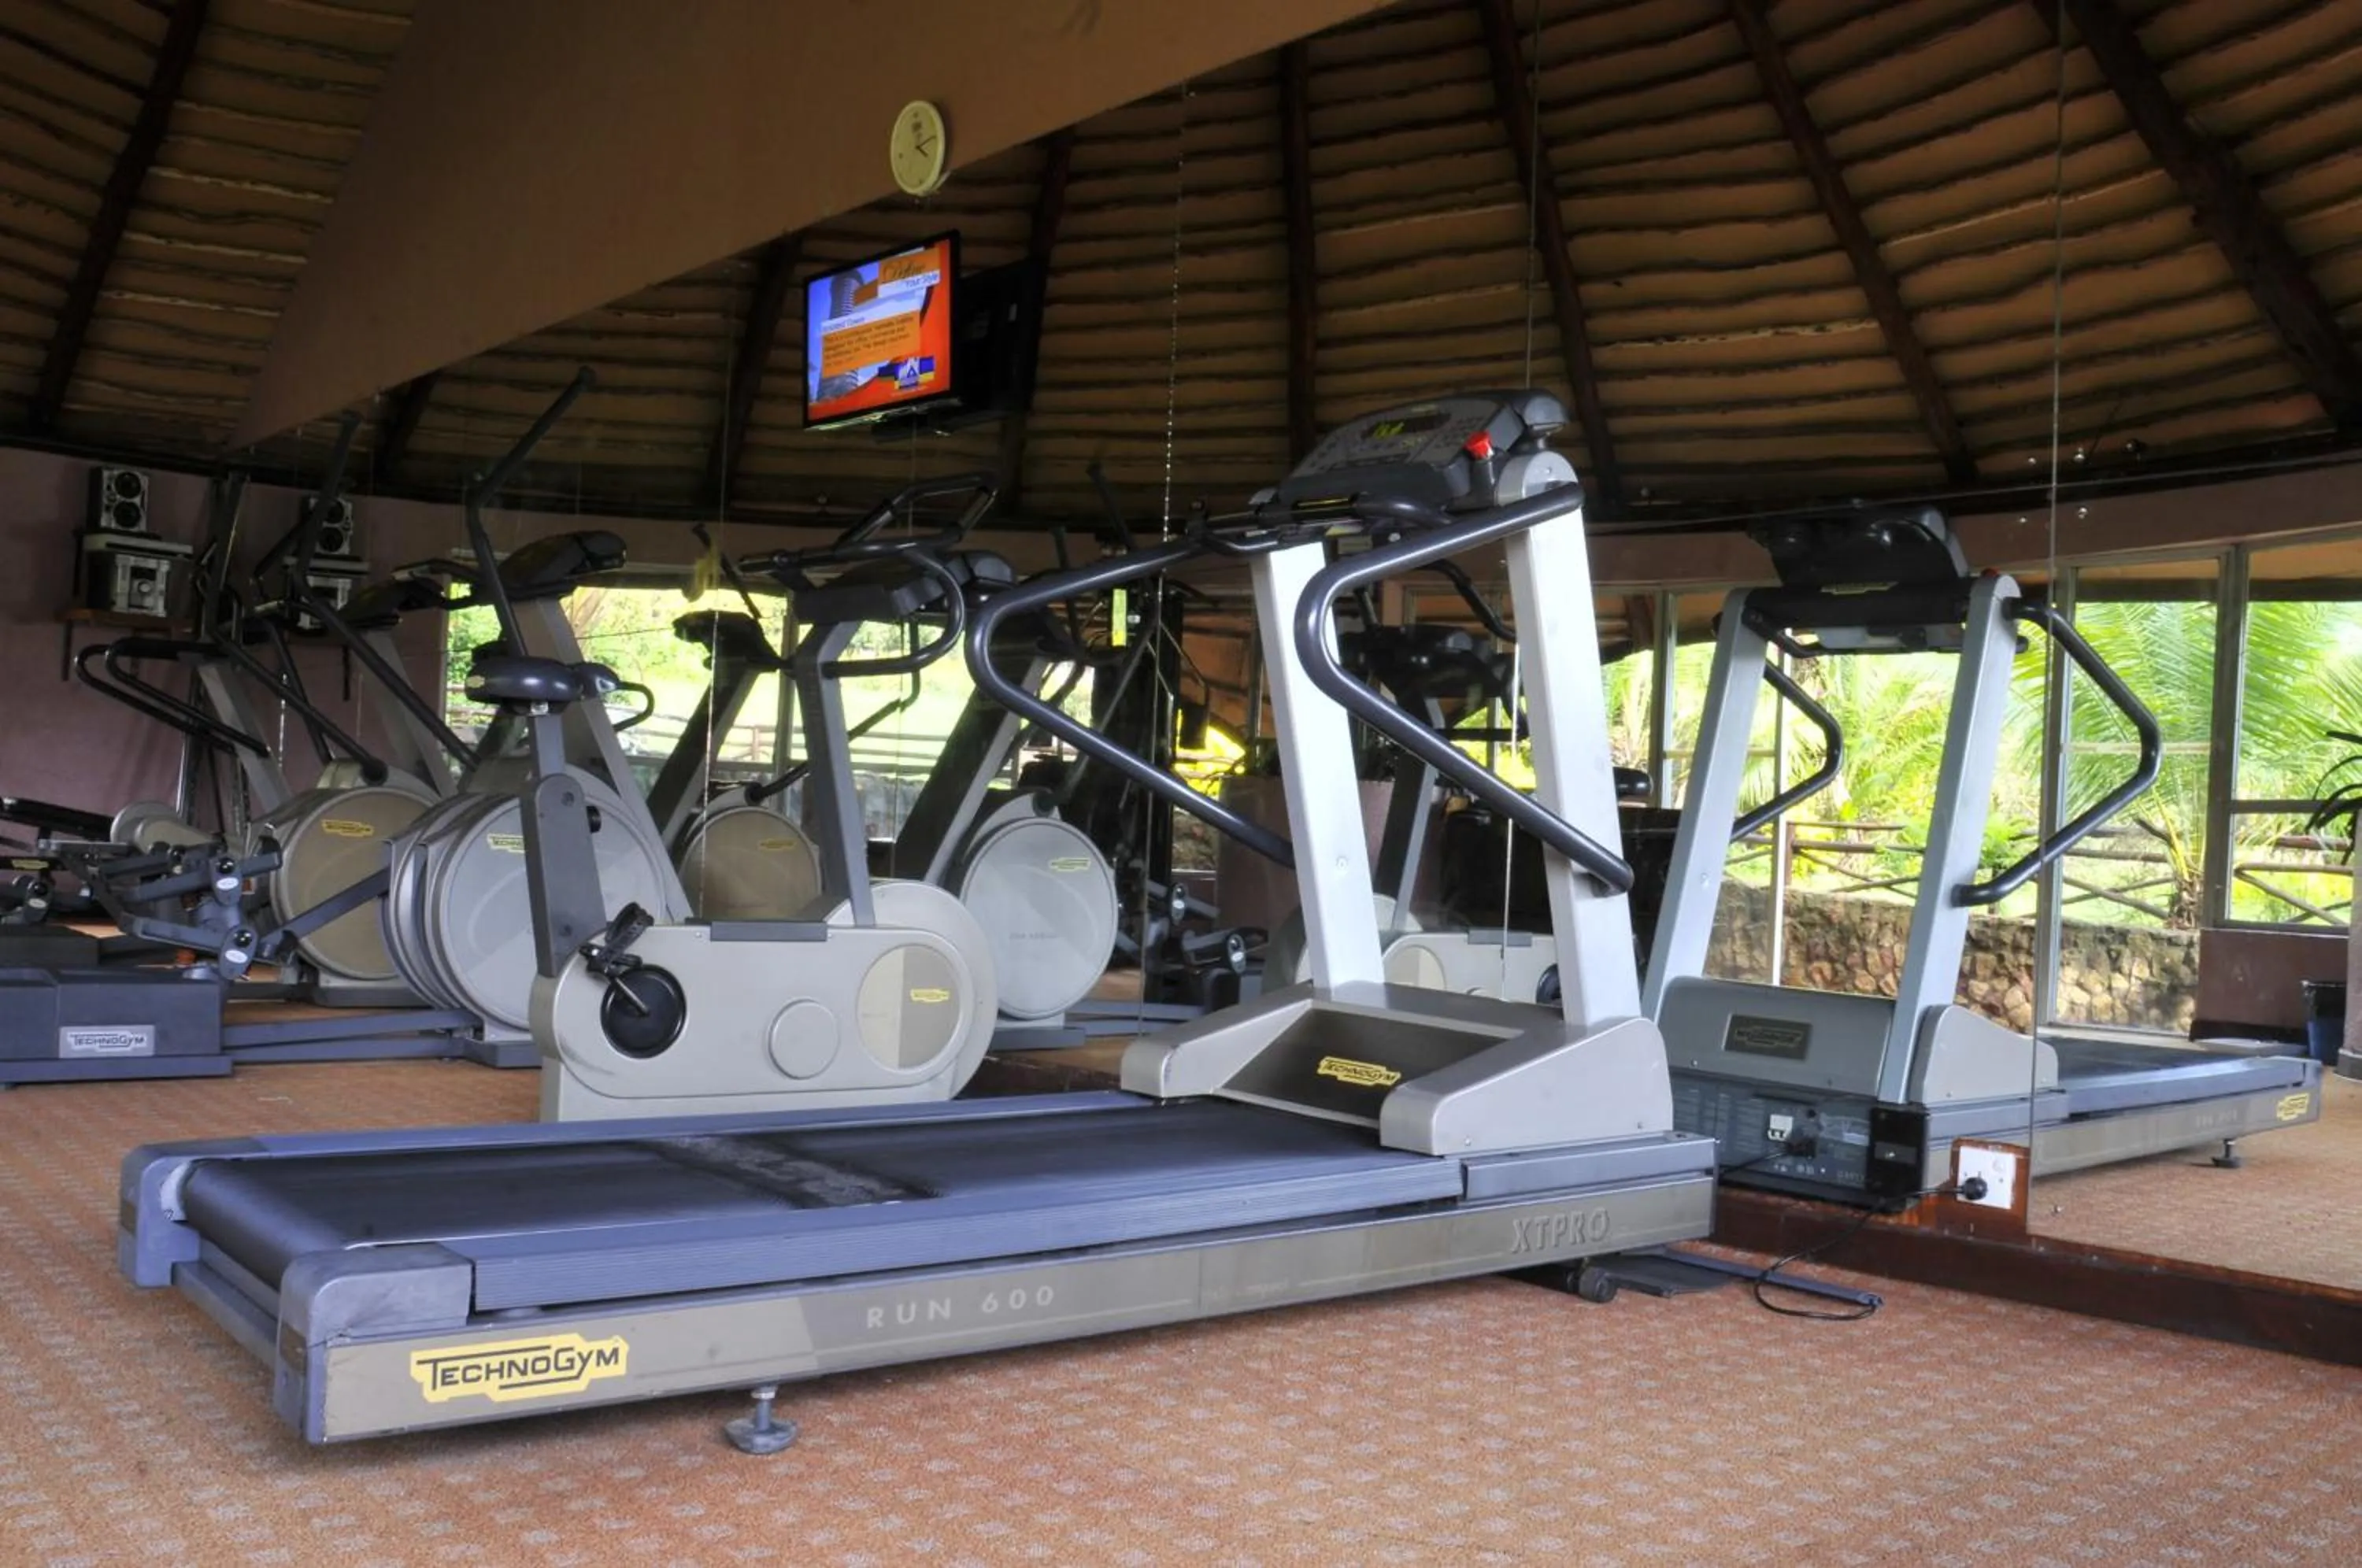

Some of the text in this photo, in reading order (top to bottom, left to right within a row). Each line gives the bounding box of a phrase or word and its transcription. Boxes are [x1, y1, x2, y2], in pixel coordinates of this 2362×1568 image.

[1511, 1206, 1610, 1254] XTPRO
[867, 1285, 1054, 1329] RUN 600
[416, 1345, 620, 1391] TECHNOGYM
